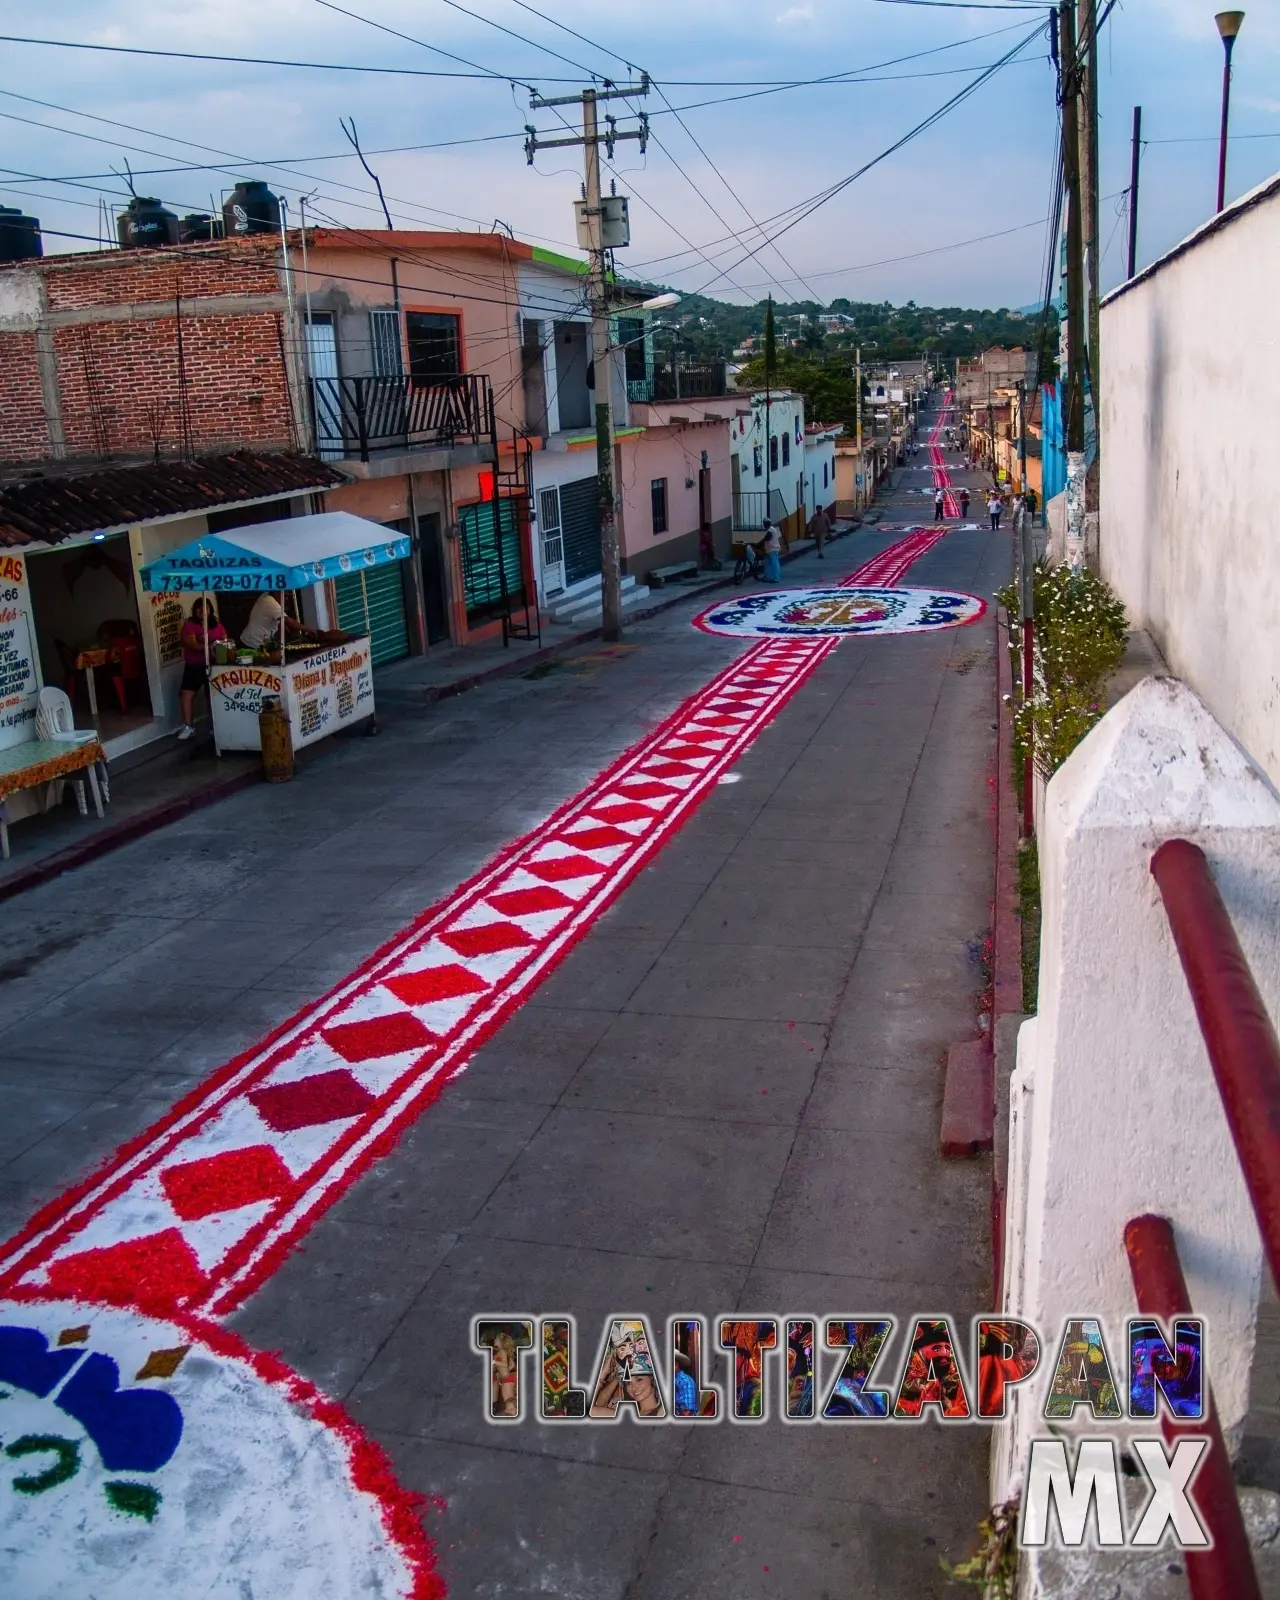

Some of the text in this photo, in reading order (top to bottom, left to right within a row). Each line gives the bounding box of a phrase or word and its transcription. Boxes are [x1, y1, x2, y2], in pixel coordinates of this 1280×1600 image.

[167, 557, 262, 569] TAQUIZAS
[160, 573, 287, 590] 734-129-0718
[303, 646, 348, 670] TAQUERIA
[210, 668, 282, 693] TAQUIZAS
[247, 688, 263, 700] Tel
